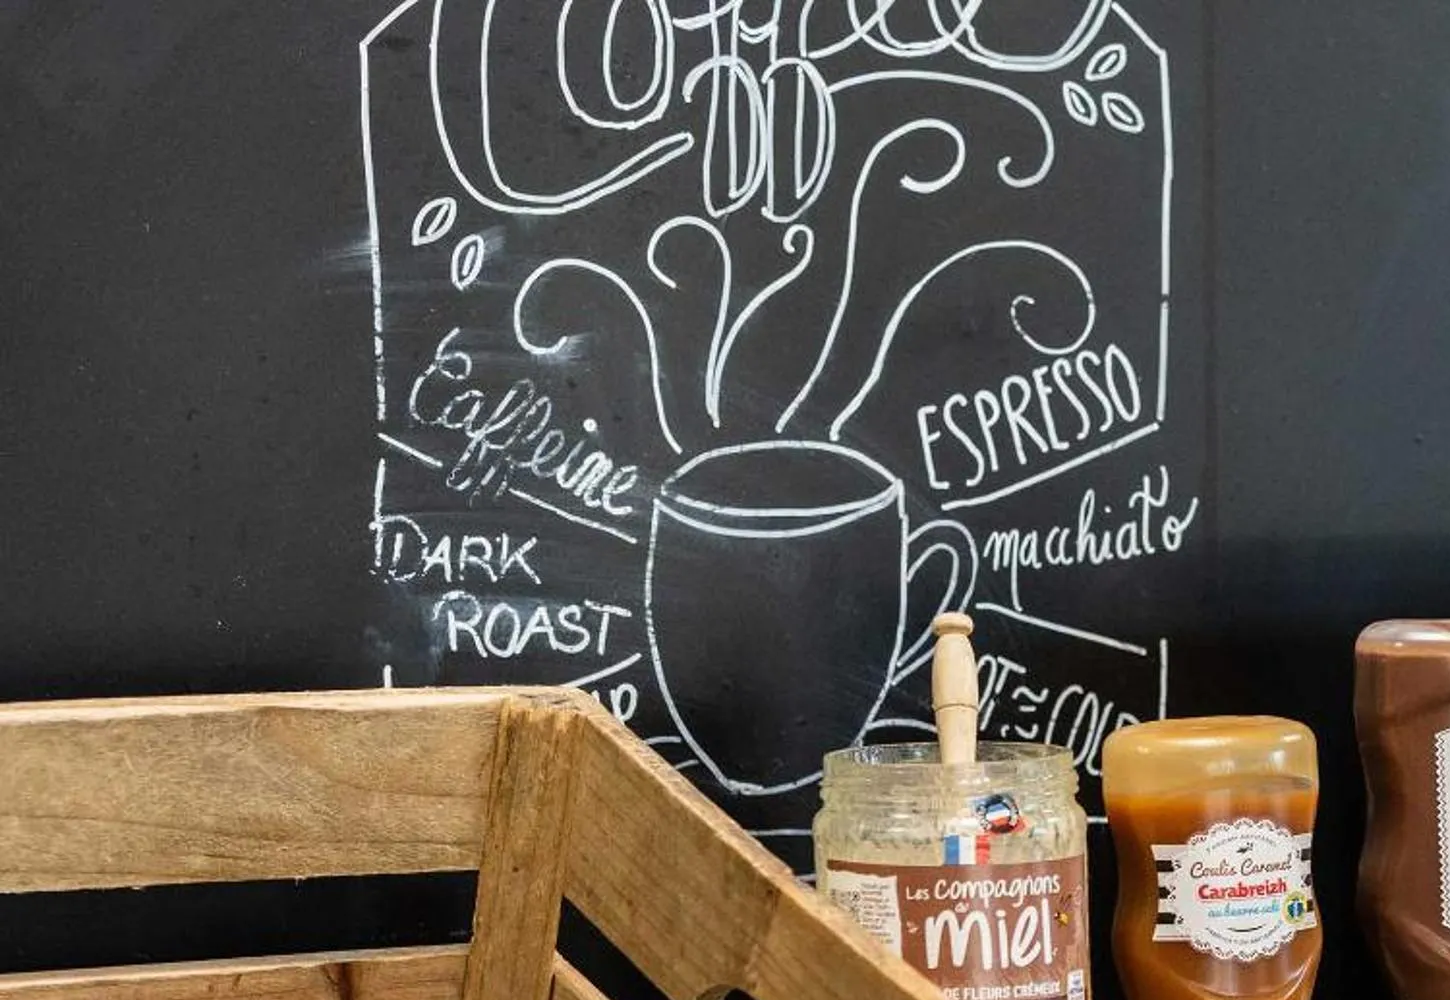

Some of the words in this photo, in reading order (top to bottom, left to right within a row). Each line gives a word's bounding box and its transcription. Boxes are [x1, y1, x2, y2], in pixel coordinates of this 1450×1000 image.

[408, 326, 639, 515] Caffeine
[916, 343, 1142, 490] ESPRESSO
[368, 514, 542, 585] DARK
[982, 464, 1199, 612] macchiato
[430, 590, 632, 658] ROAST
[906, 886, 930, 900] Les
[934, 874, 1061, 908] Compagnons
[1198, 878, 1288, 900] Carabreizh
[963, 984, 1011, 1000] FLEURS
